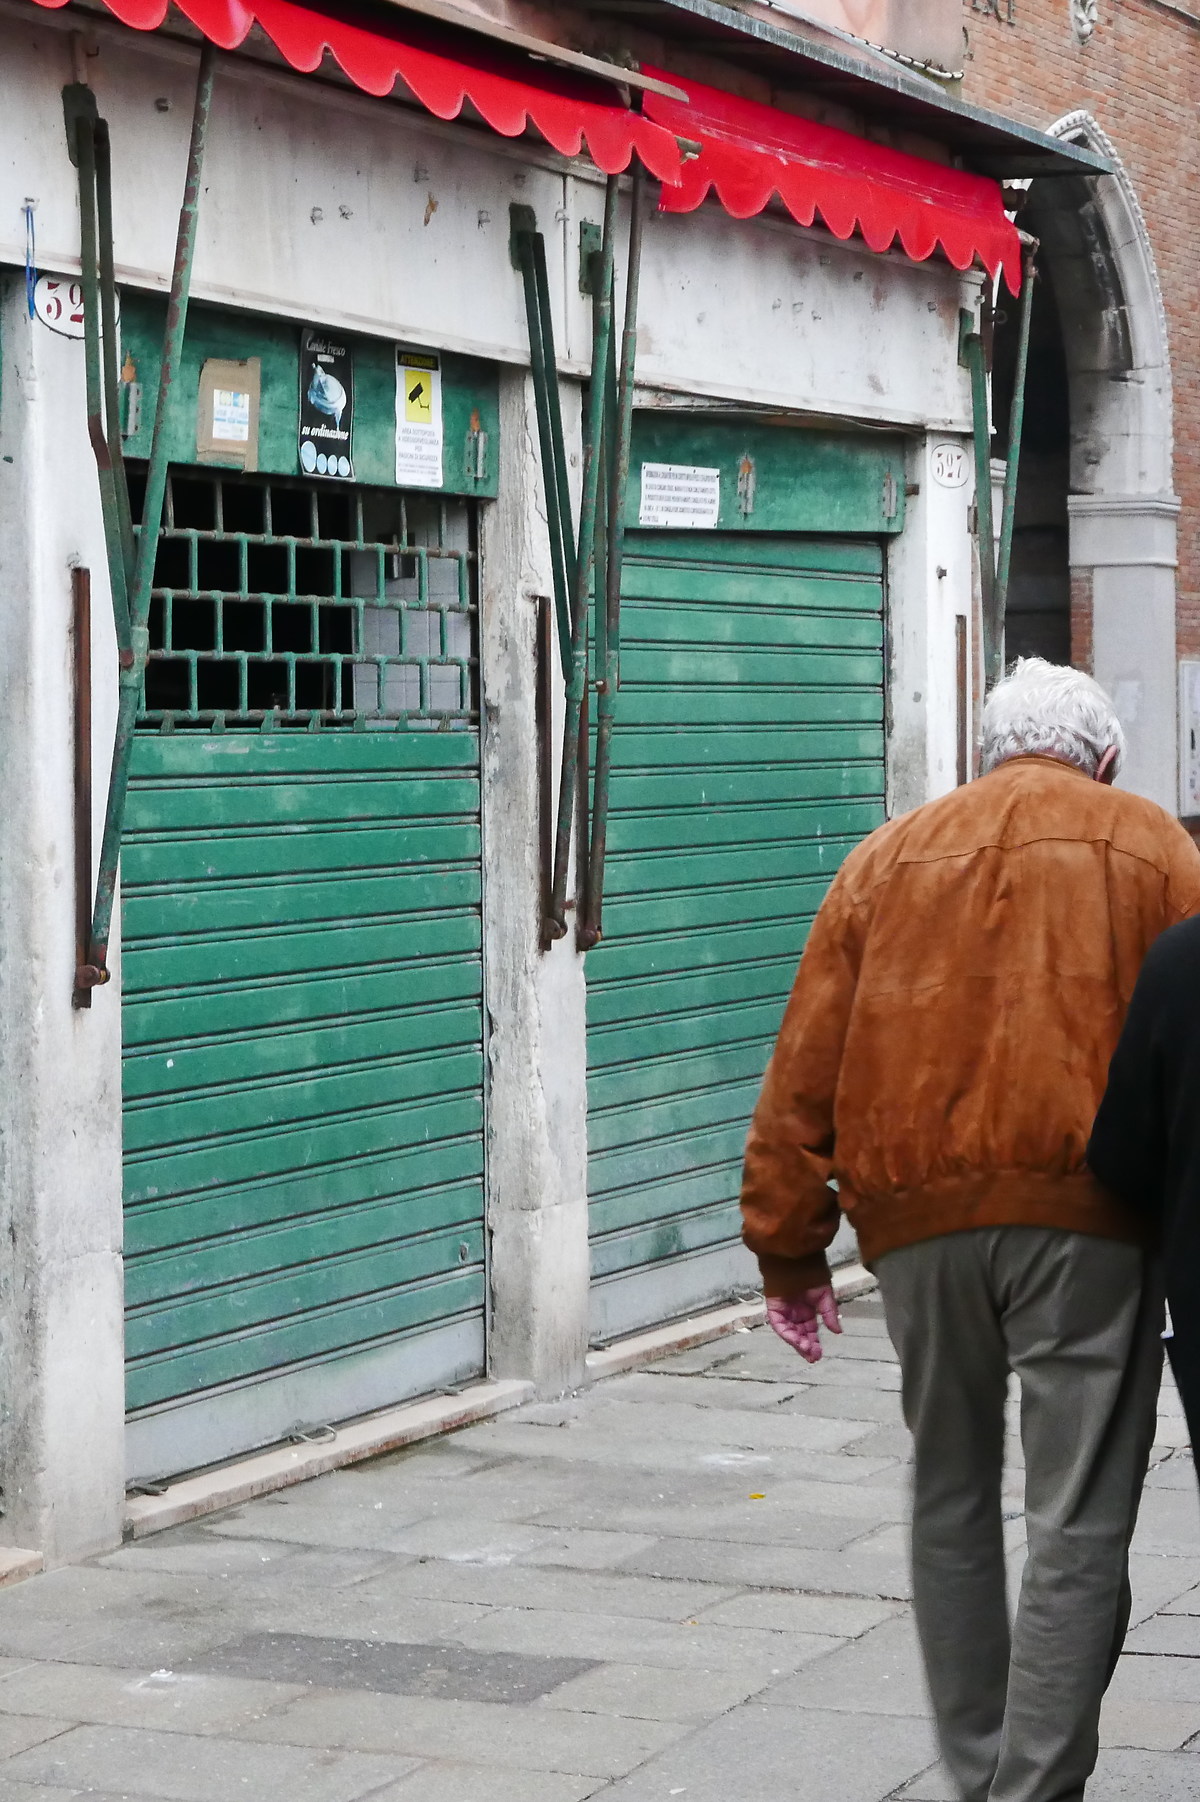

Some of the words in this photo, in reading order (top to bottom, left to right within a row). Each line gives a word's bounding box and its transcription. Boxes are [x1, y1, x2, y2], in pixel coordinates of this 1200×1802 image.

[45, 281, 86, 323] 32
[301, 425, 311, 435] su
[310, 423, 349, 441] ordinazione
